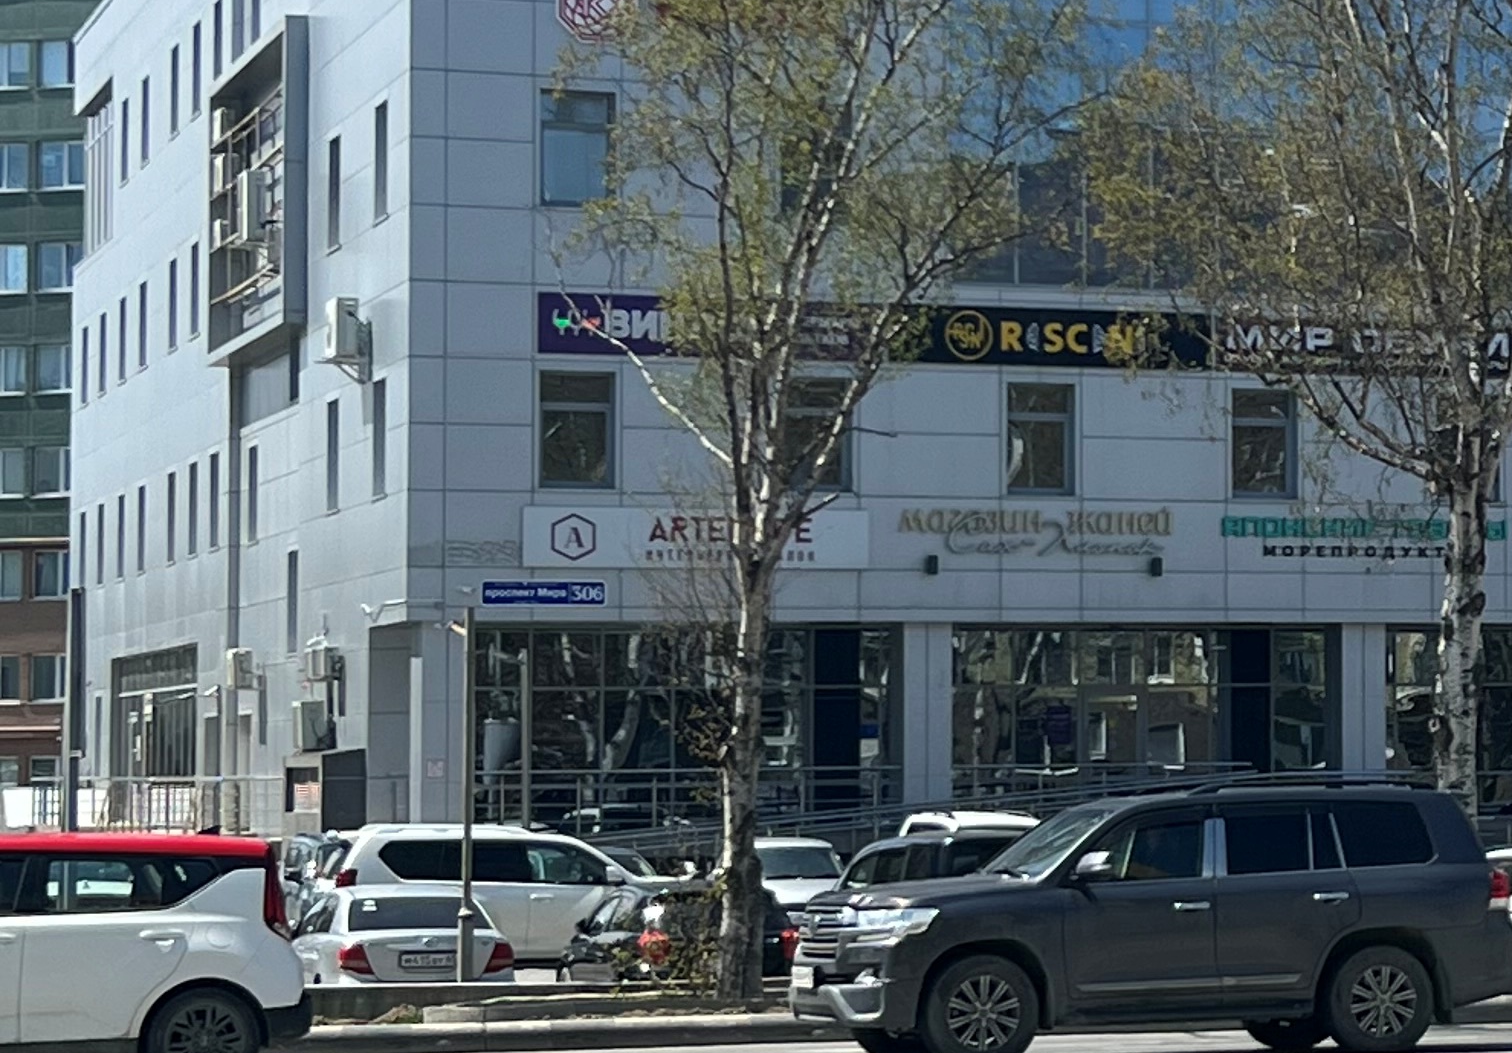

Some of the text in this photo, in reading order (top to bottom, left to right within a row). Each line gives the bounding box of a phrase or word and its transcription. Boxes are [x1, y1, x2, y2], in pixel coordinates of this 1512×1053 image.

[1263, 545, 1447, 561] МОРЕПРОДУКТ
[537, 587, 567, 599] Мира
[571, 585, 603, 602] 306
